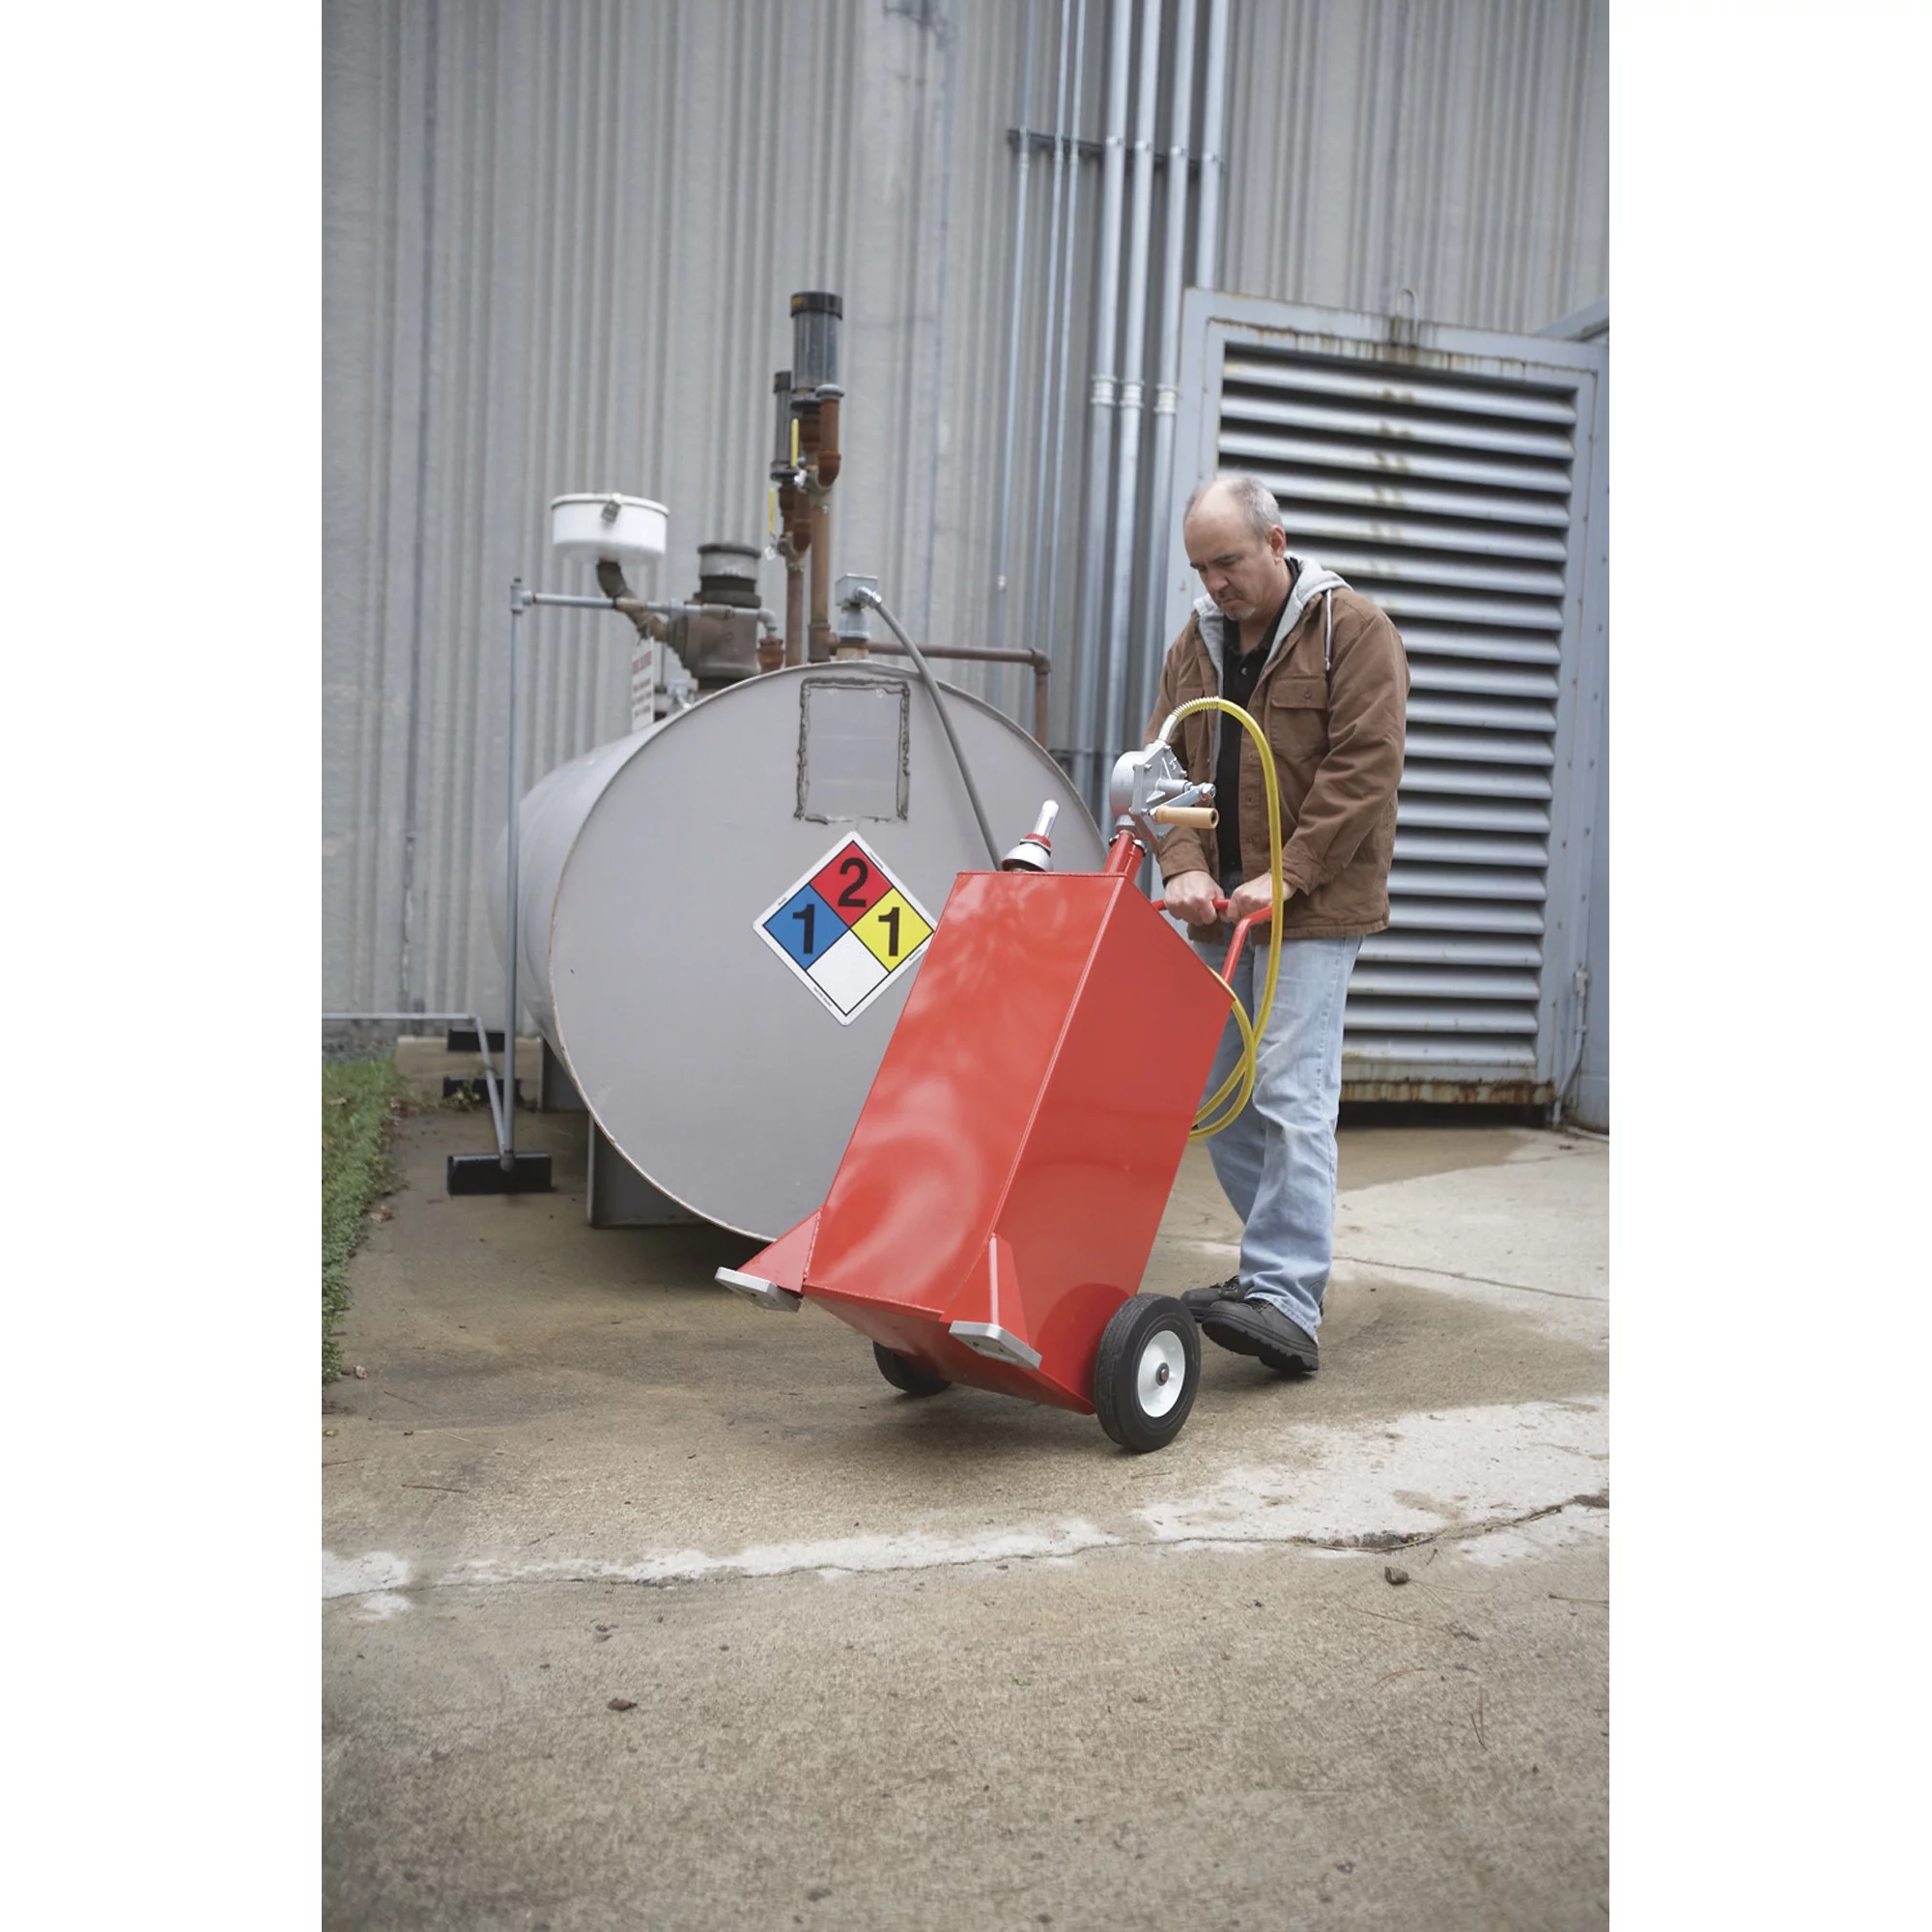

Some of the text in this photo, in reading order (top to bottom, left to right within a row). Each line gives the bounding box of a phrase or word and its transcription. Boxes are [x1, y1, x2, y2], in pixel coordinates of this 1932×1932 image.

[838, 858, 867, 907] 2
[792, 904, 814, 954] 1
[878, 907, 899, 956] 1
